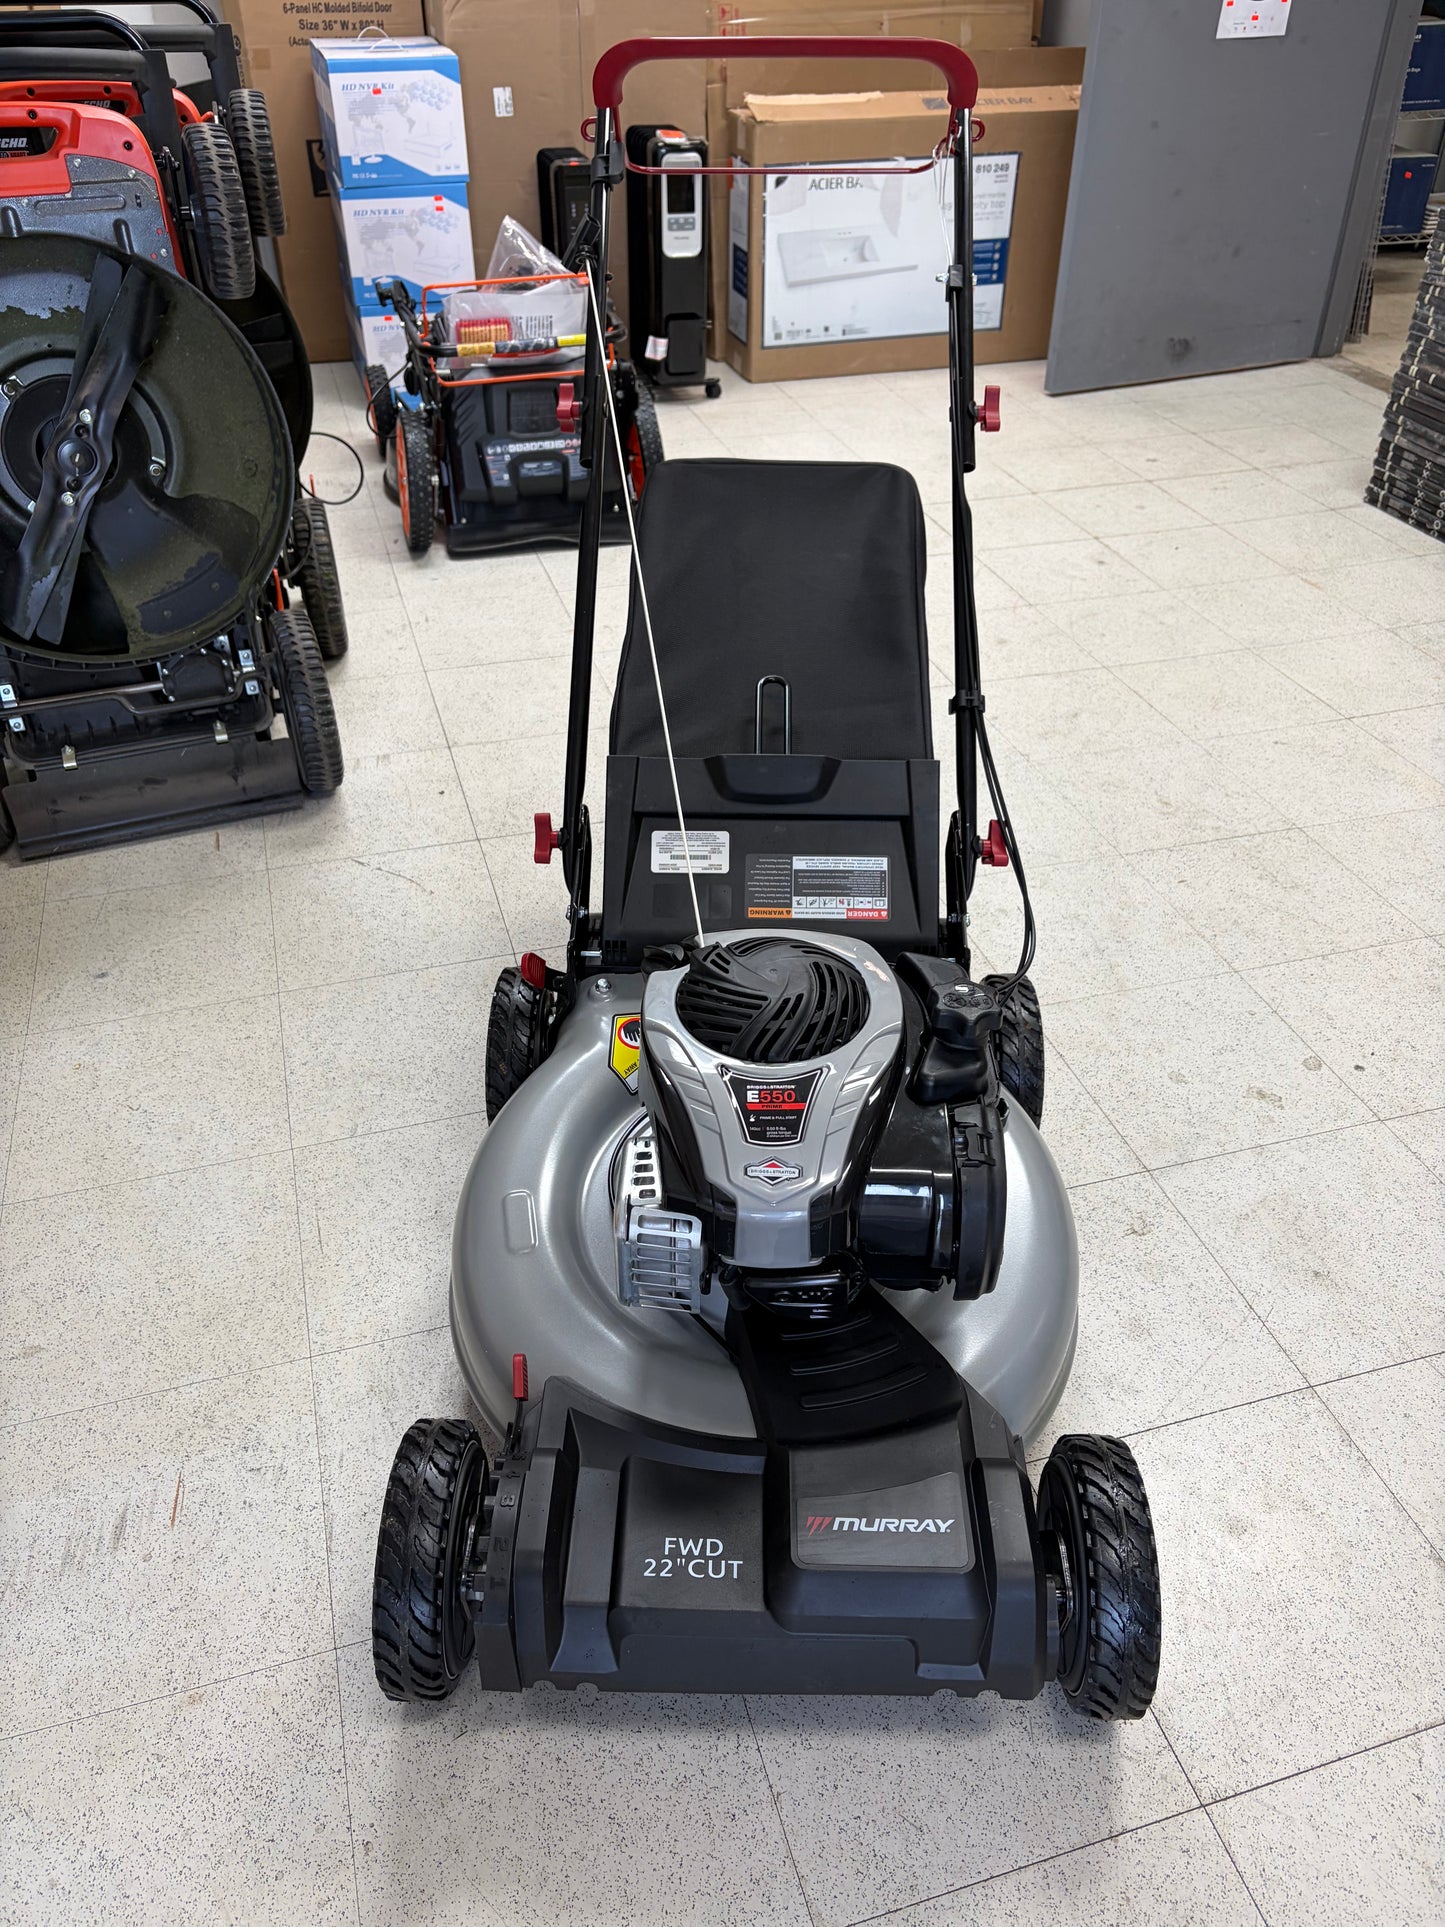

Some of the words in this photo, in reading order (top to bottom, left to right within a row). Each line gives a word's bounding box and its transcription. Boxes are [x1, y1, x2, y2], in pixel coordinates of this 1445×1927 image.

[283, 3, 311, 13] 6-Panel
[312, 3, 323, 13] HC
[324, 3, 350, 13] Molded
[352, 2, 374, 12] Bifold
[374, 3, 392, 12] Door
[299, 19, 319, 30] Size
[322, 20, 337, 30] 36"
[340, 20, 349, 30] W
[352, 22, 357, 30] x
[376, 20, 384, 30] H
[289, 37, 310, 46] (Actu
[341, 83, 356, 91] HD
[381, 82, 394, 90] Kit
[0, 138, 27, 148] CHO
[808, 177, 844, 191] ACIER
[845, 176, 863, 190] BA
[353, 209, 368, 217] HD
[369, 208, 389, 216] NVR
[372, 325, 385, 333] HD
[749, 908, 785, 916] WARNING
[623, 1061, 638, 1075] AWAY
[746, 1090, 796, 1103] E550
[832, 1517, 955, 1533] MURRAY
[664, 1537, 724, 1557] FWD
[643, 1558, 744, 1580] 22"CUT
